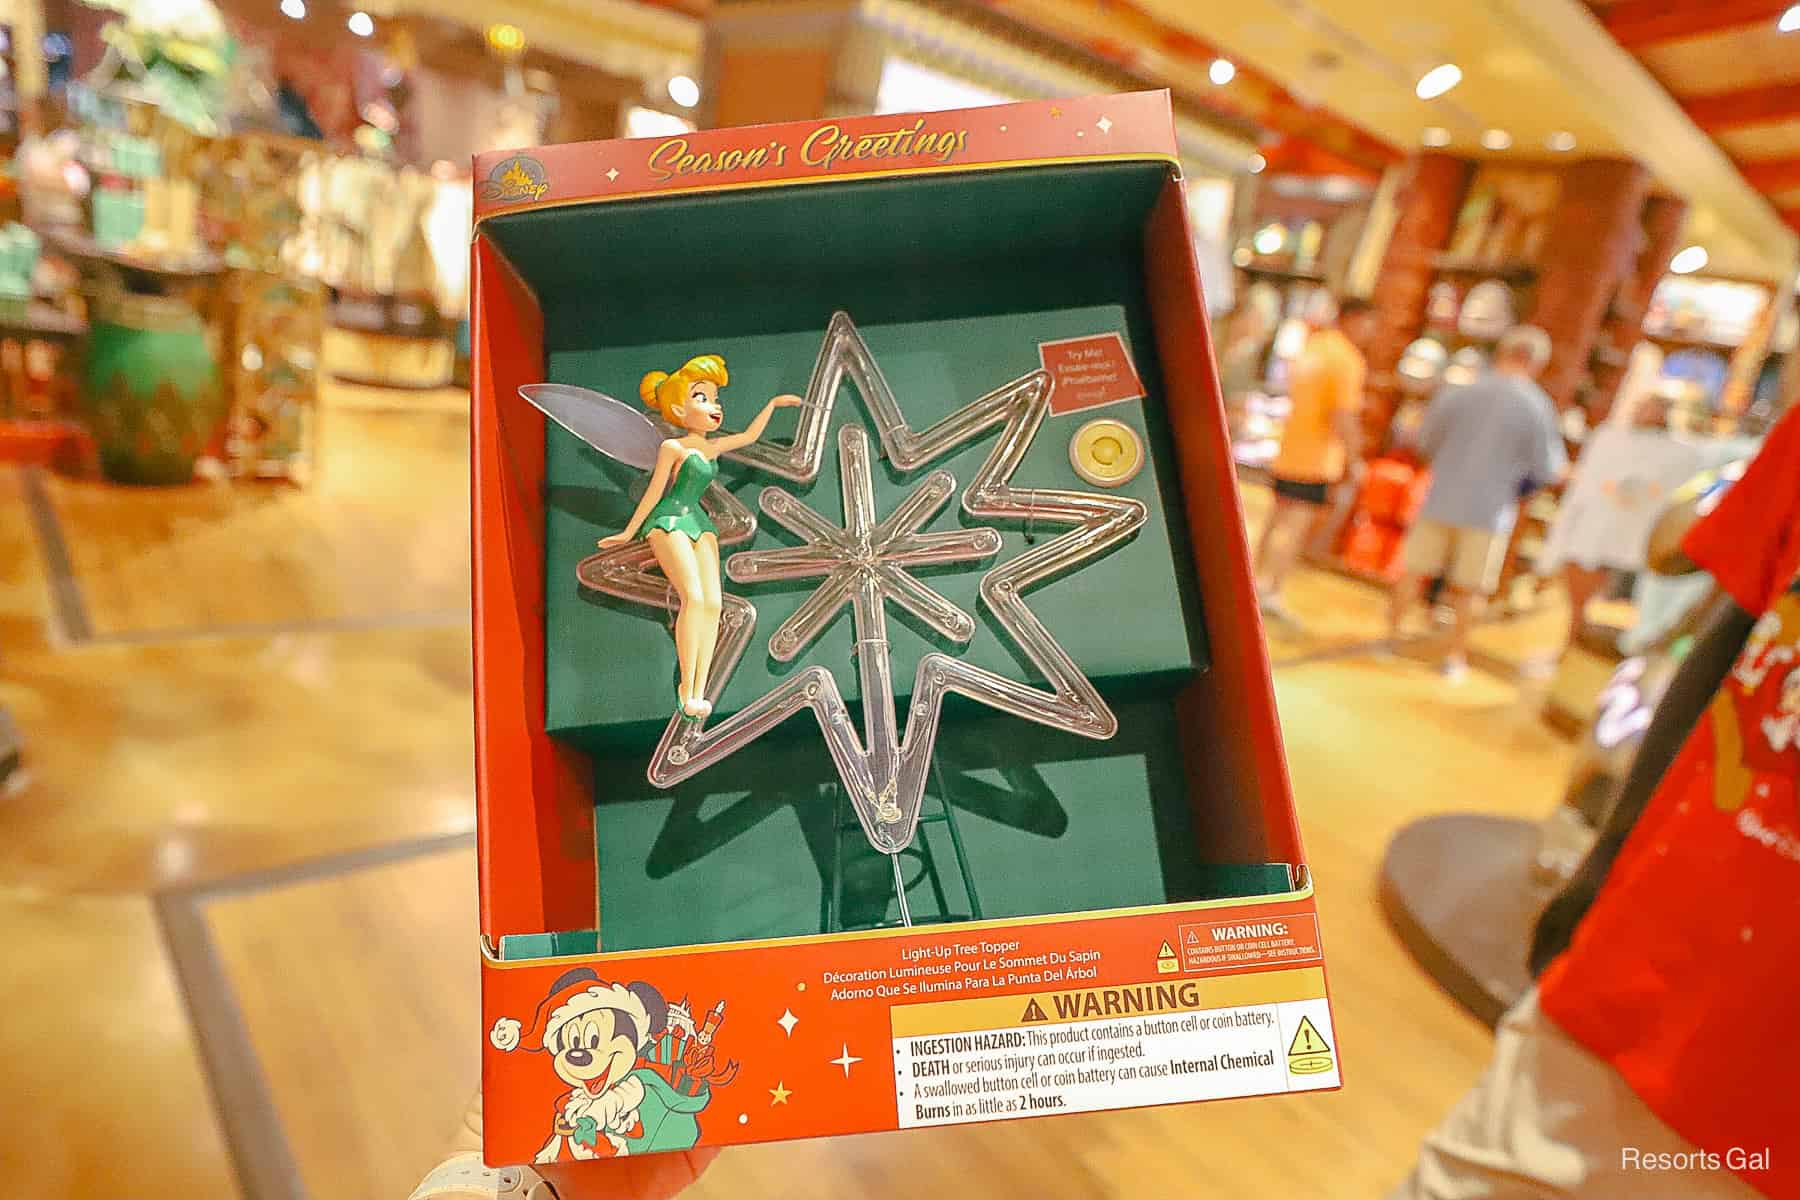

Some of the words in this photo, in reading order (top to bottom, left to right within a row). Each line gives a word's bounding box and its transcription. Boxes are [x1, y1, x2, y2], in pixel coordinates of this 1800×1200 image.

[648, 138, 788, 181] Season's
[800, 119, 968, 169] Greetings
[1211, 922, 1289, 941] WARNING:
[823, 969, 887, 983] Décoration
[889, 963, 952, 979] Lumineuse
[954, 961, 980, 972] Pour
[983, 958, 997, 970] Le
[999, 954, 1048, 969] Sommet
[1050, 952, 1066, 964] Du
[1069, 949, 1101, 963] Sapin
[902, 945, 952, 962] Light-Up
[952, 943, 978, 955] Tree
[980, 941, 1020, 955] Topper
[830, 987, 874, 1001] Adorno
[876, 984, 900, 997] Que
[903, 982, 917, 995] Se
[920, 979, 962, 993] Ilumina
[965, 977, 990, 989] Para
[992, 975, 1006, 986] La
[1008, 972, 1041, 985] Punta
[1044, 969, 1063, 982] Del
[1066, 965, 1097, 980] Árbol
[1053, 982, 1200, 1020] WARNING
[910, 1036, 972, 1057] INGESTION
[974, 1031, 1026, 1051] HAZARD:
[1027, 1029, 1048, 1047] This
[1050, 1026, 1090, 1048] product
[1091, 1022, 1134, 1041] contains
[1136, 1025, 1143, 1037] a
[1144, 1019, 1179, 1036] button
[1181, 1016, 1198, 1032] cell
[1200, 1017, 1211, 1031] or
[1212, 1012, 1234, 1029] coin
[1235, 1009, 1275, 1028] battery.
[912, 1059, 951, 1078] DEATH
[952, 1060, 964, 1074] or
[965, 1056, 1003, 1074] serious
[1005, 1053, 1035, 1073] injury
[1037, 1052, 1056, 1067] can
[1058, 1049, 1086, 1063] occur
[1088, 1046, 1097, 1062] if
[1097, 1041, 1146, 1064] ingested.
[914, 1083, 922, 1099] A
[924, 1077, 980, 1098] swallowed
[982, 1073, 1018, 1093] button
[1020, 1072, 1038, 1089] cell
[1040, 1073, 1052, 1088] or
[1054, 1069, 1076, 1086] coin
[1077, 1063, 1116, 1086] battery
[1118, 1065, 1137, 1081] can
[1138, 1062, 1169, 1078] cause
[1170, 1055, 1218, 1076] Internal
[1220, 1049, 1275, 1070] Chemical
[915, 1102, 951, 1120] Burns
[952, 1101, 964, 1117] in
[965, 1101, 977, 1115] as
[979, 1095, 1004, 1114] little
[1006, 1098, 1018, 1112] as
[1019, 1095, 1027, 1110] 2
[1028, 1092, 1067, 1109] hours.
